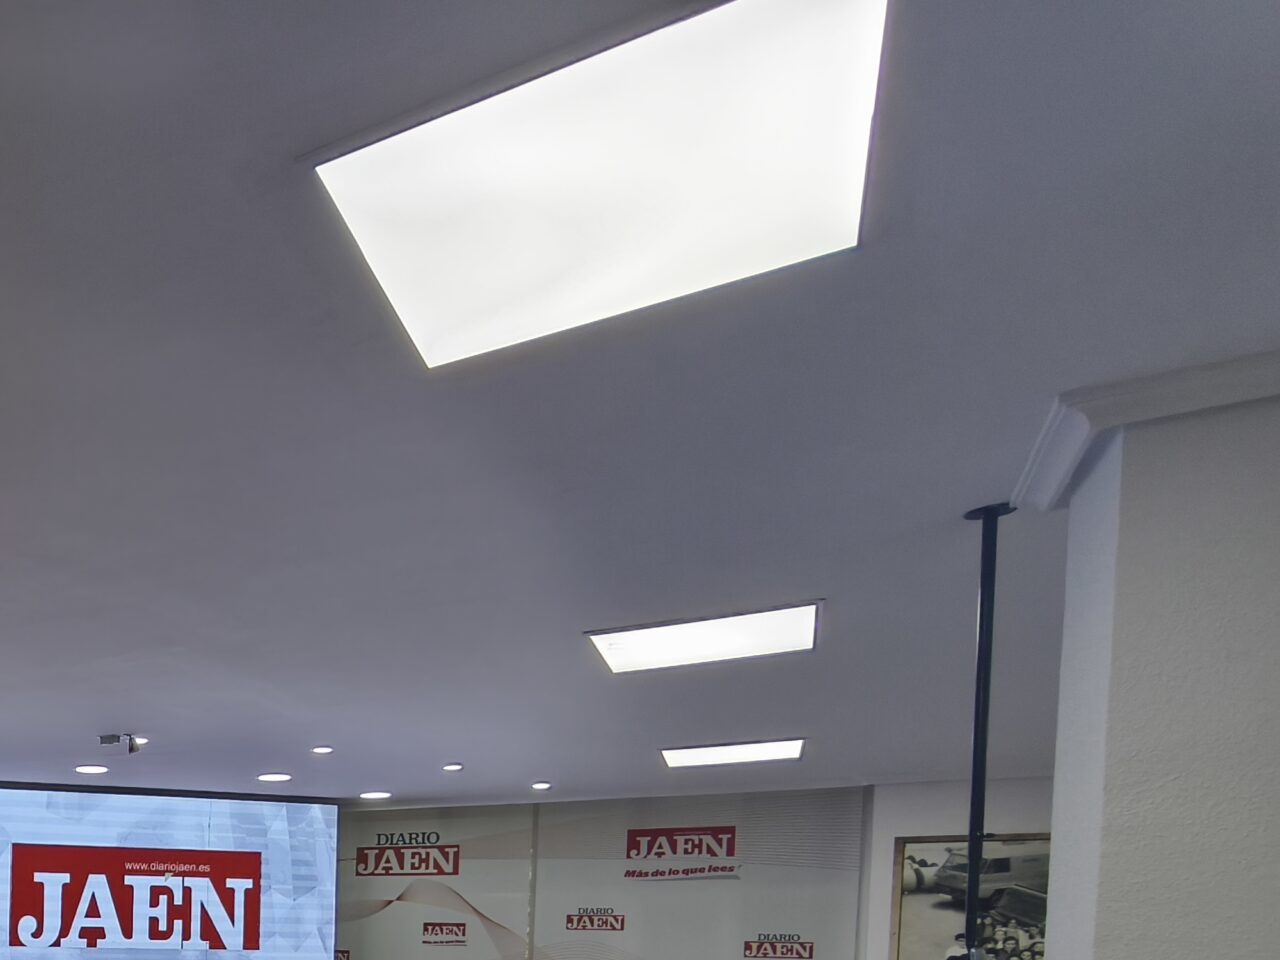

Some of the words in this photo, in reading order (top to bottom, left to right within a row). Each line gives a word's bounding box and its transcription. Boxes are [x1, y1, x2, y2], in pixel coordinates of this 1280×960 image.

[376, 831, 440, 846] DIARIO
[629, 834, 732, 859] JAEN
[125, 860, 211, 873] www.diariojaen.es
[357, 847, 458, 874] JAEN
[624, 869, 649, 878] Más
[650, 869, 666, 877] de
[668, 868, 679, 876] lo
[681, 866, 705, 876] que
[707, 865, 735, 873] lees
[578, 907, 614, 915] DIARIO
[567, 916, 624, 929] JAEN
[424, 925, 464, 936] JAEN
[758, 933, 801, 941] DIARIO
[745, 942, 813, 959] JAEN
